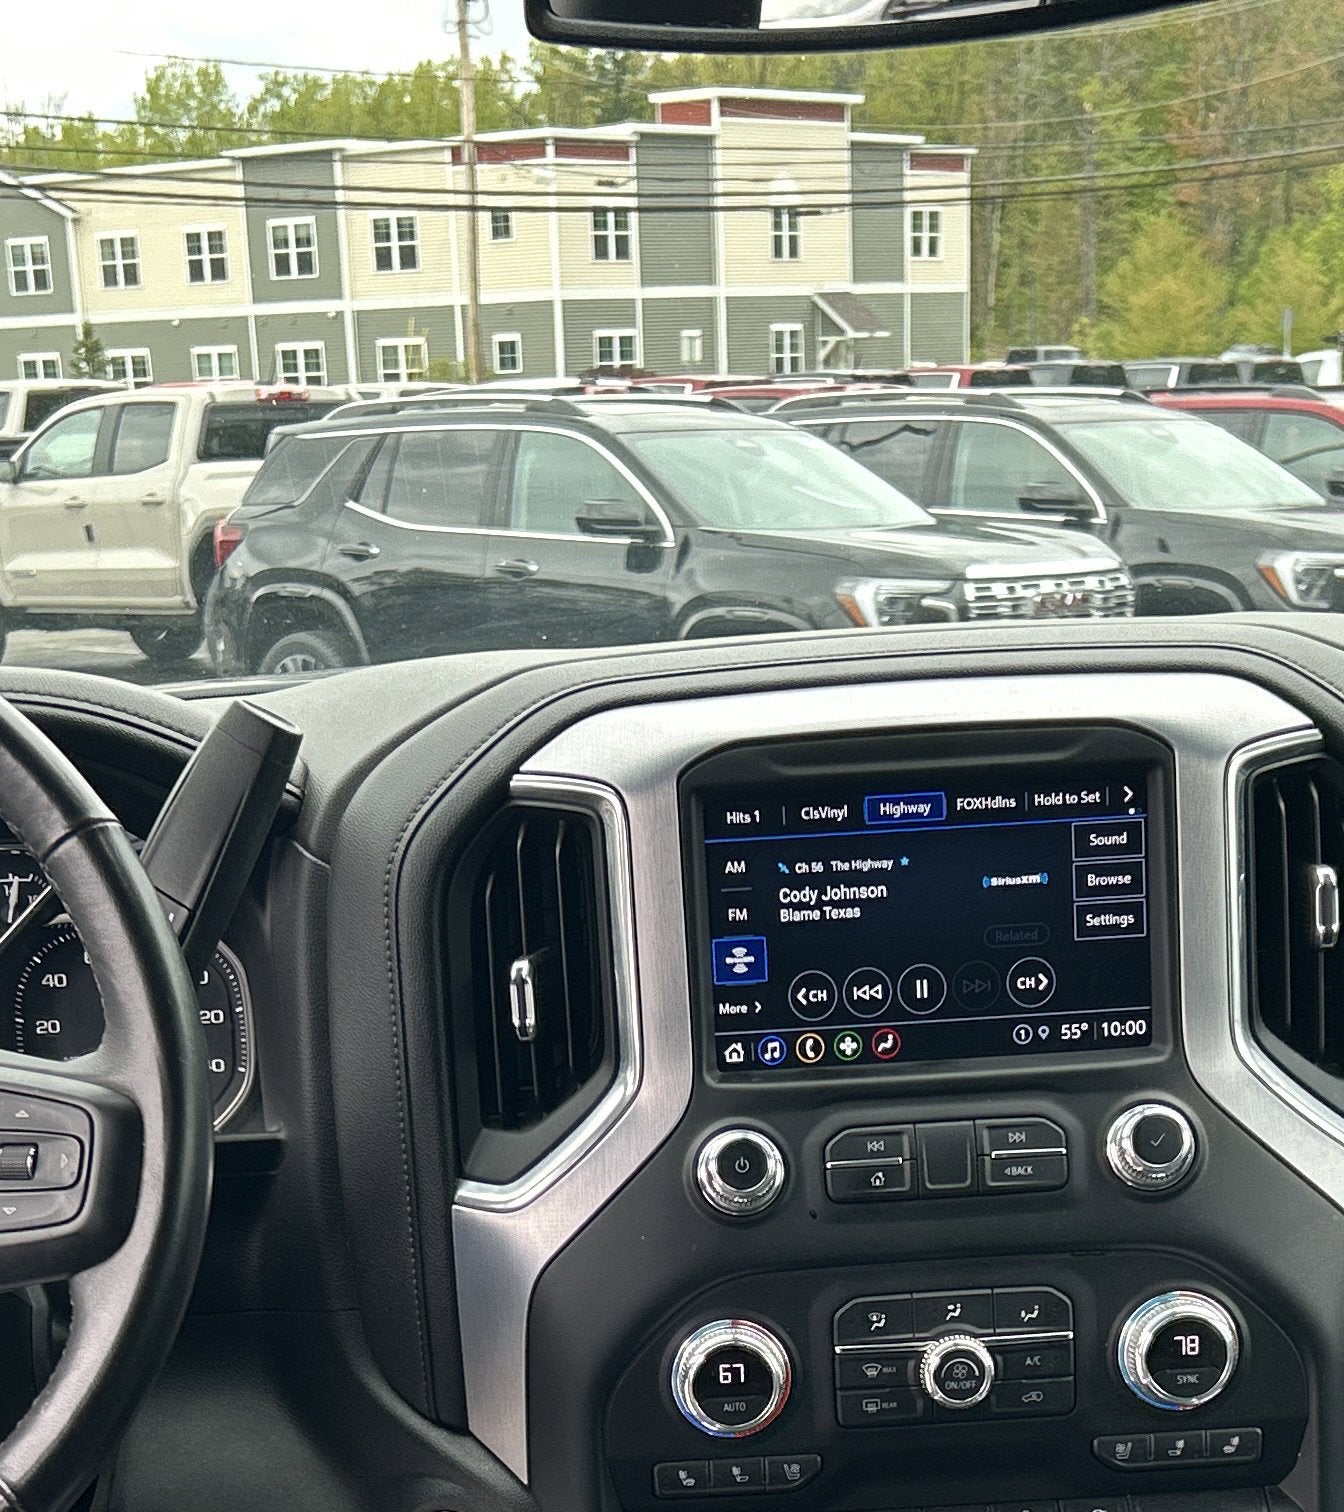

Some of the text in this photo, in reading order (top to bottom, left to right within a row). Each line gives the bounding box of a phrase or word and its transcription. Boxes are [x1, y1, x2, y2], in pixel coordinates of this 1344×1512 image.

[1034, 790, 1101, 806] Hold to Set
[726, 809, 761, 825] Hits 1
[880, 801, 932, 819] Highway
[1089, 831, 1128, 846] Sound
[725, 860, 746, 874] AM
[795, 862, 809, 874] Ch
[831, 859, 850, 872] The
[851, 857, 894, 872] Highway
[1087, 873, 1132, 887] Browse
[779, 884, 887, 905] Cody Johnson
[728, 908, 748, 921] FM
[780, 906, 861, 922] Blame Texas
[1085, 913, 1135, 928] Settings
[995, 929, 1039, 942] Related
[41, 973, 67, 988] 40
[718, 1001, 748, 1015] More
[199, 1009, 224, 1024] 20
[35, 1020, 61, 1035] 20
[1101, 1019, 1147, 1037] 10:00
[1011, 1166, 1033, 1176] BACK
[1173, 1334, 1199, 1356] 78
[1025, 1356, 1041, 1366] A/C
[718, 1363, 745, 1384] 67
[1176, 1373, 1200, 1385] SYNC
[944, 1380, 977, 1391] ON/OFF
[723, 1401, 747, 1413] AUTO
